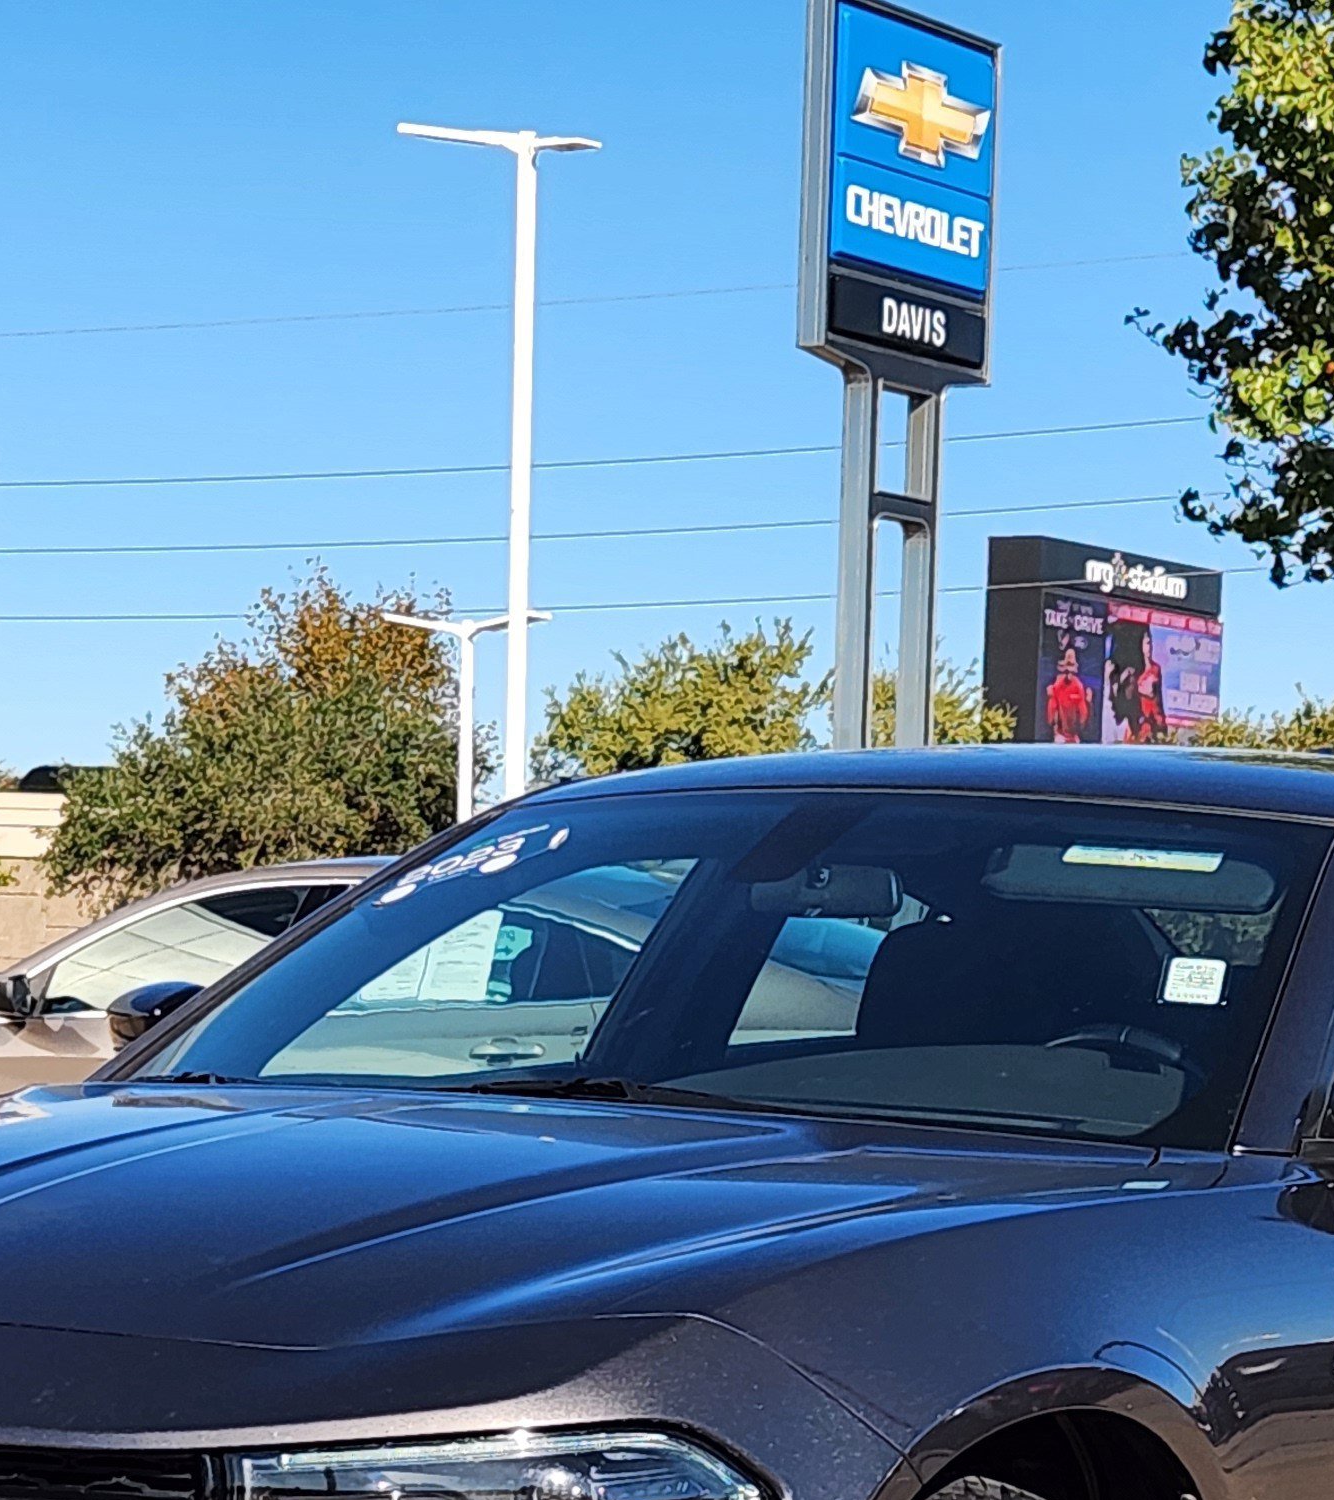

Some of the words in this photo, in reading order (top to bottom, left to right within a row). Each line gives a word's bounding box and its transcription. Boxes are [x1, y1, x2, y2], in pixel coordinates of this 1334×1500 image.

[845, 183, 985, 259] CHEVROLET
[881, 296, 947, 348] DAVIS
[1127, 563, 1188, 600] stadium
